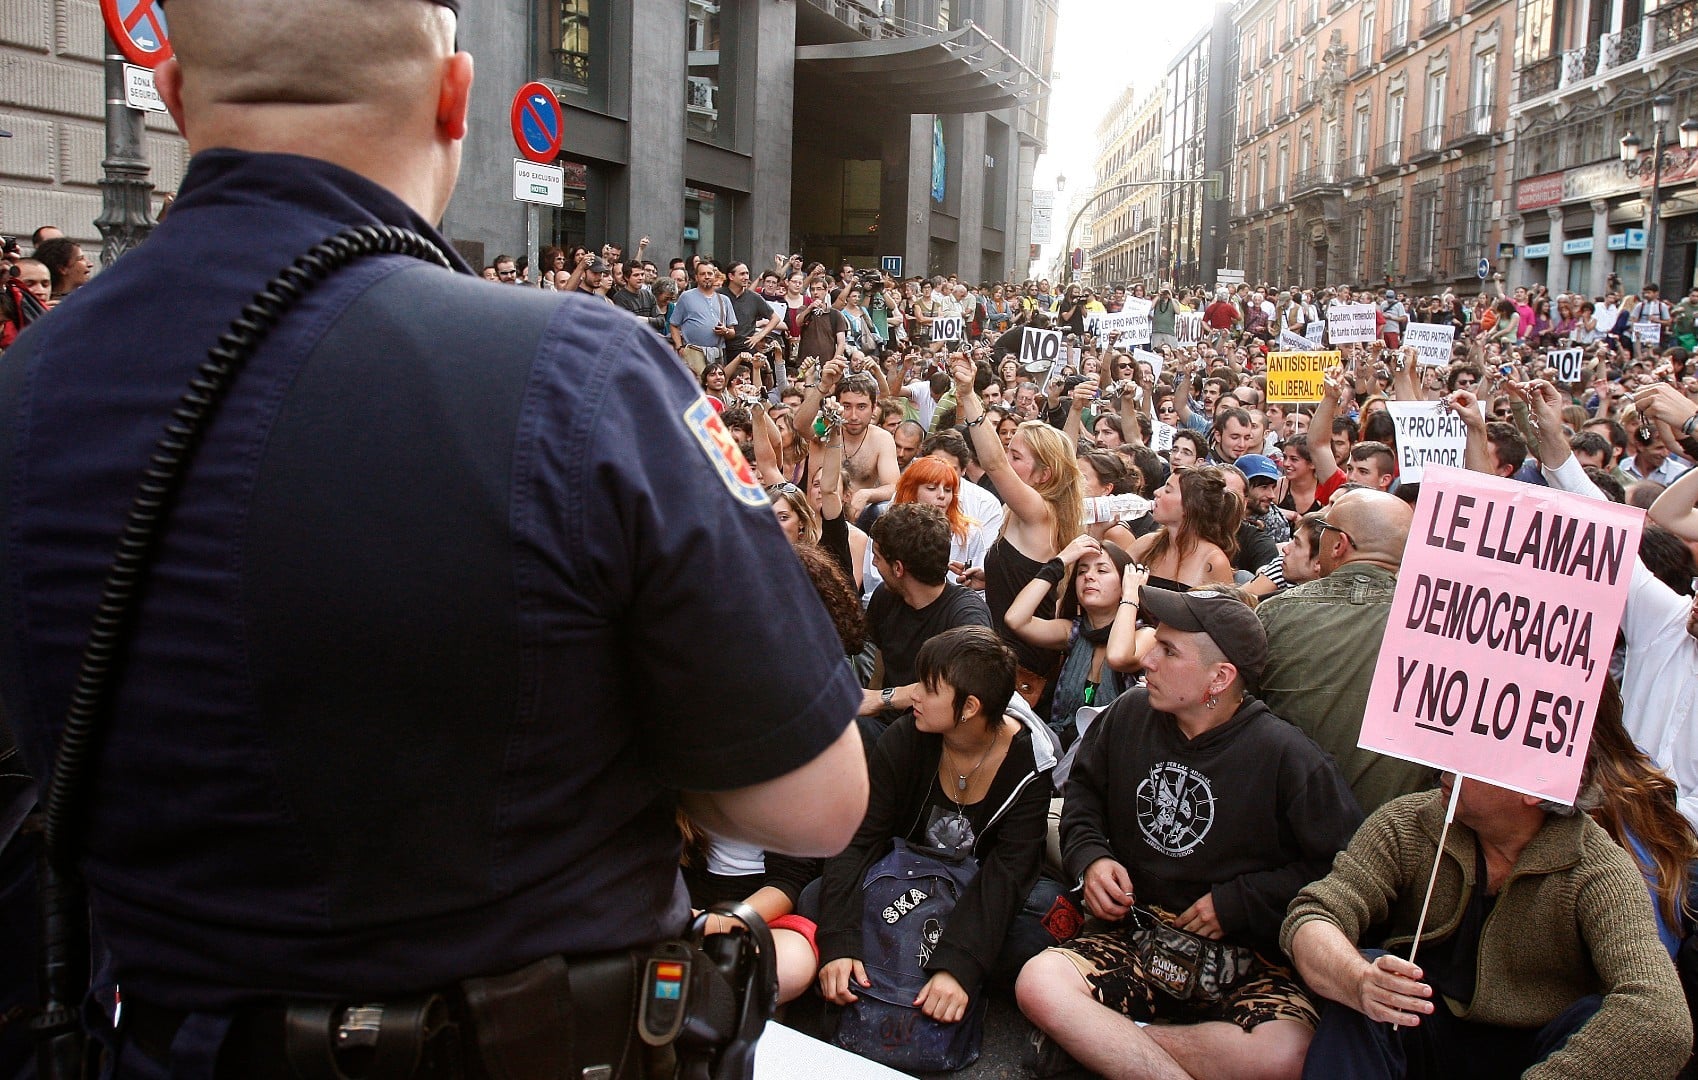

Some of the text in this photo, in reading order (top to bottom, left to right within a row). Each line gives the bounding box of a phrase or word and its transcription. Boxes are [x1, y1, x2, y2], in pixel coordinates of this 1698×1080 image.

[518, 170, 530, 178] USO
[531, 172, 559, 183] EXCLUSIVO
[530, 184, 548, 195] HOTEL
[1102, 314, 1147, 330] LEY PRO PATRÓN
[1330, 309, 1375, 324] Zapatero, remendón
[934, 318, 960, 340] NO!
[1407, 329, 1452, 344] LEY PRO PATRÓN
[1023, 330, 1059, 362] NO
[1269, 356, 1340, 372] ANTISISTEMA?
[1548, 352, 1580, 380] NO!
[1268, 380, 1279, 396] Su
[1281, 380, 1314, 396] LIBERAL
[1409, 417, 1434, 438] PRO
[1425, 490, 1627, 586] LE LLAMAN
[1405, 573, 1597, 683] DEMOCRACIA,
[1393, 656, 1585, 758] Y NO LO ES!
[882, 888, 928, 924] SKA
[1153, 955, 1178, 974] PUNK
[1152, 966, 1187, 983] NOT DEAD
